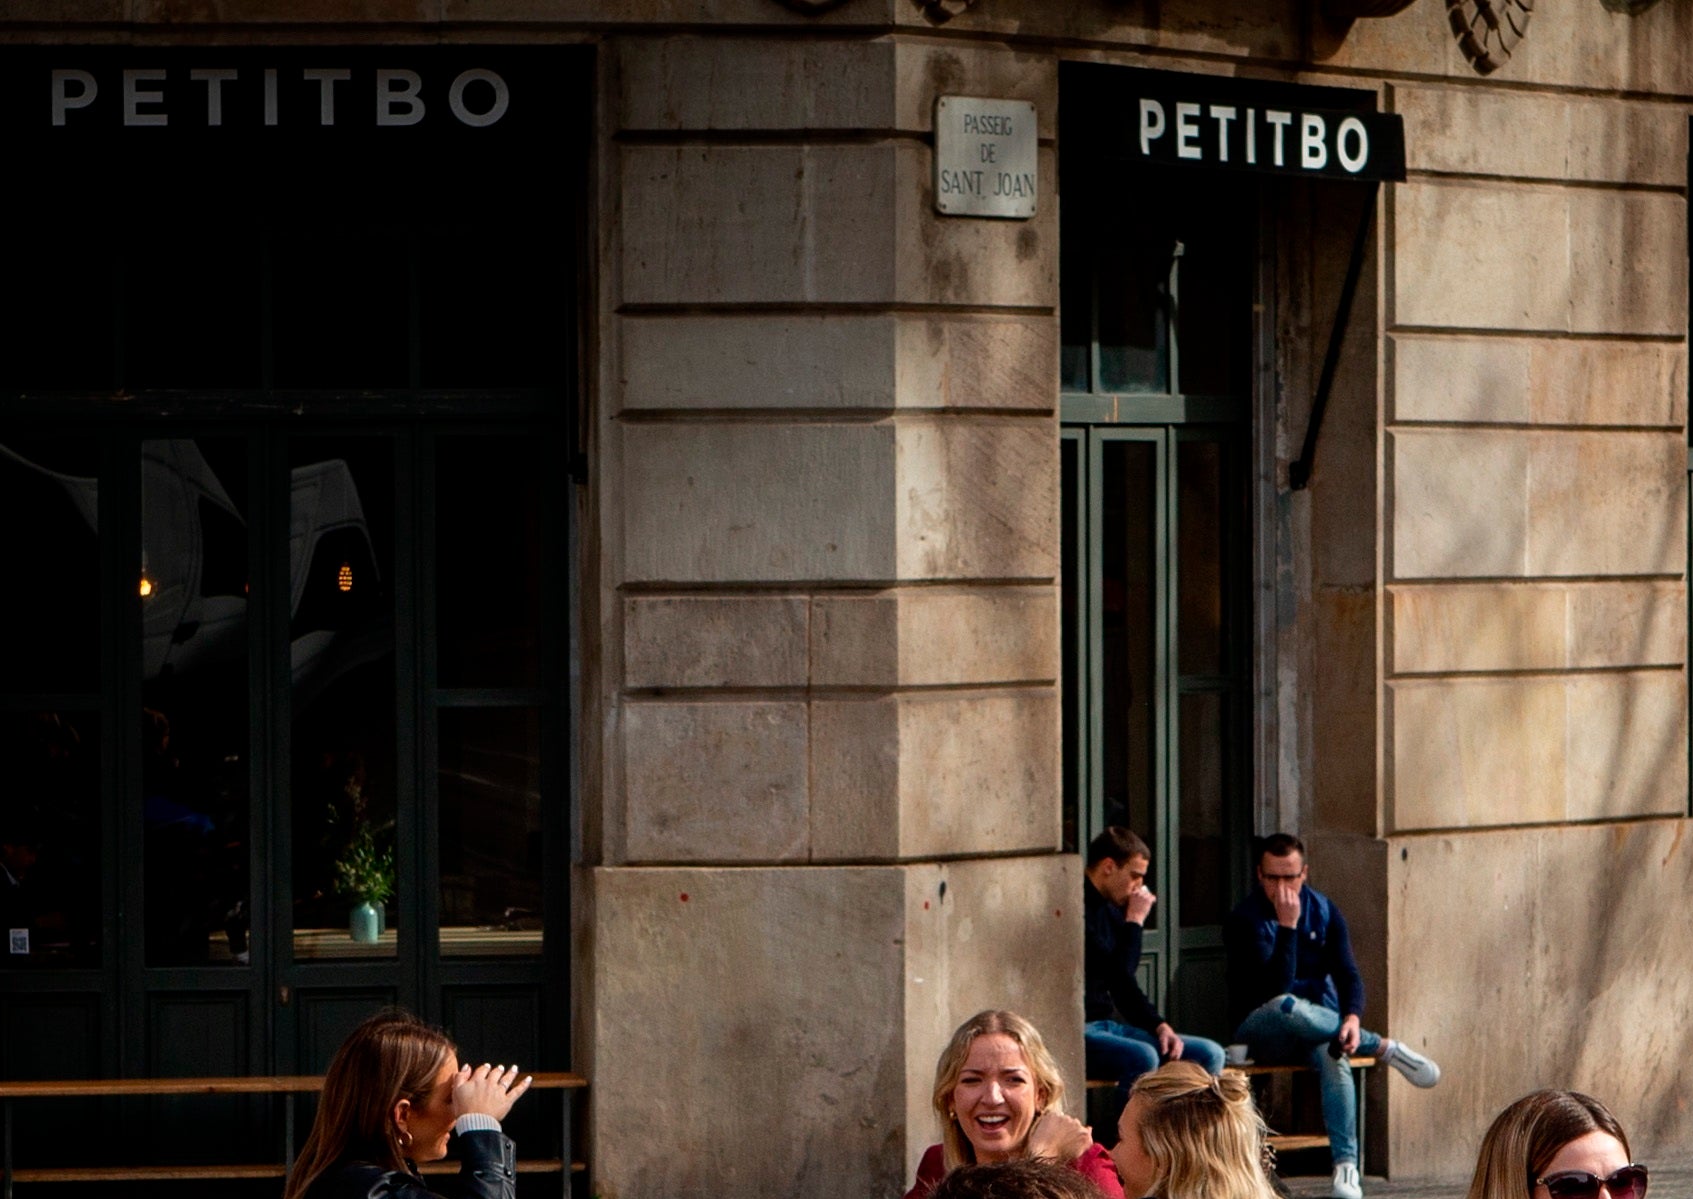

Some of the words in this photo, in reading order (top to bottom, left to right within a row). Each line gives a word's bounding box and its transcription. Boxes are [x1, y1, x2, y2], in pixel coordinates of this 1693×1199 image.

[50, 68, 511, 127] PETITBO
[963, 114, 1013, 136] PASSEIG
[1139, 98, 1369, 173] PETITBO
[980, 143, 996, 163] DE
[941, 169, 985, 195] SANT
[993, 172, 1035, 197] JOAN
